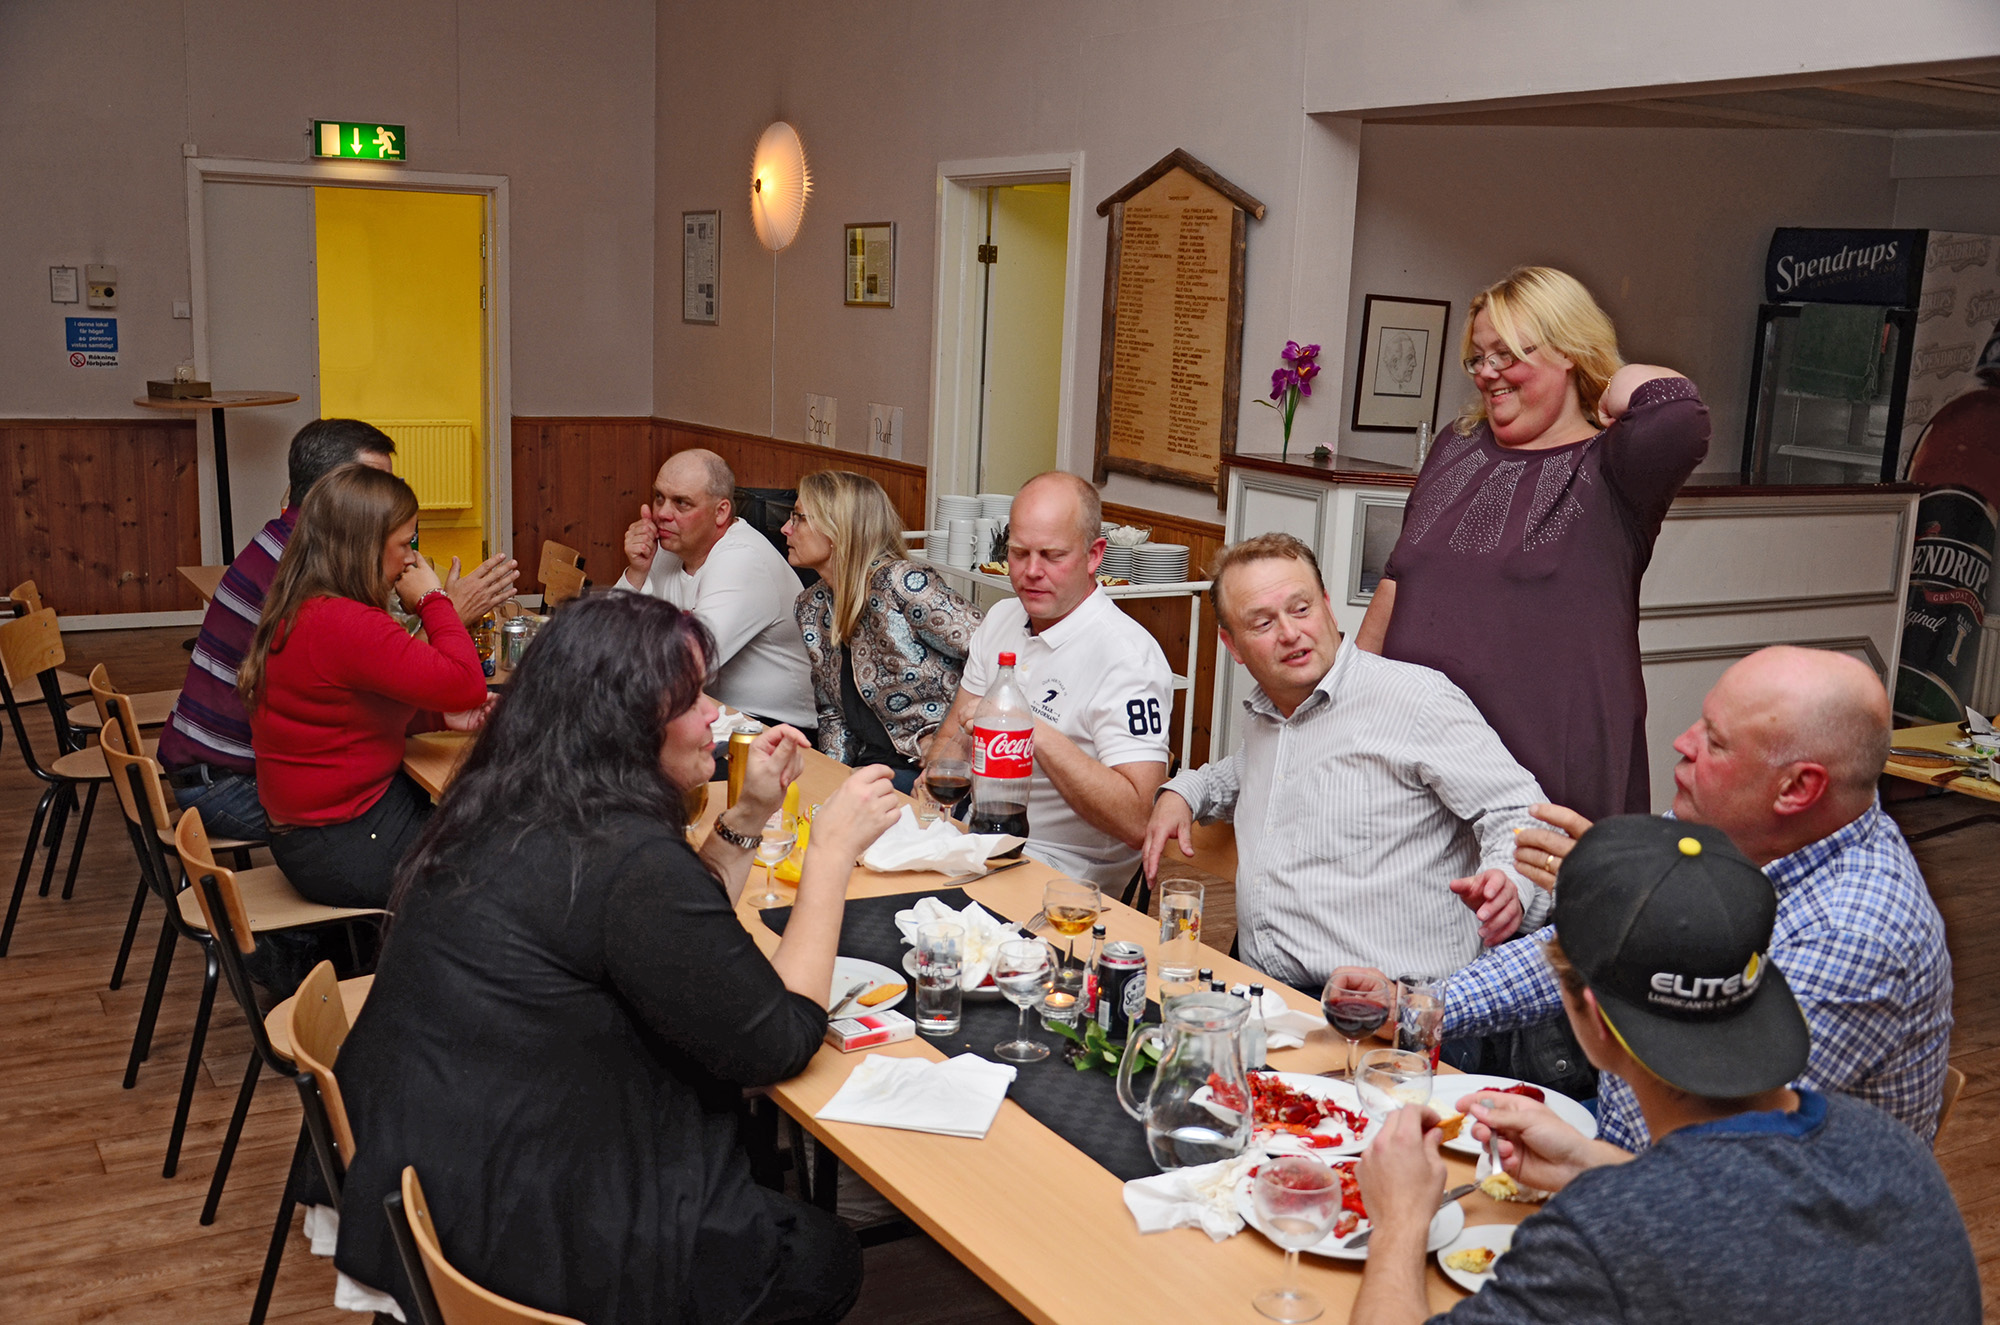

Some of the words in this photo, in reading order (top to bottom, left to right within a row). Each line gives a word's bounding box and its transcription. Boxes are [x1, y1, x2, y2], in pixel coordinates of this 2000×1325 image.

[1776, 240, 1899, 293] Spendrups
[88, 328, 104, 336] högst
[1913, 348, 1971, 375] SPENDRUPS
[875, 417, 892, 445] Pant
[1933, 591, 1969, 602] GRUNDAT
[1126, 697, 1162, 736] 86
[1650, 972, 1741, 999] ELITE
